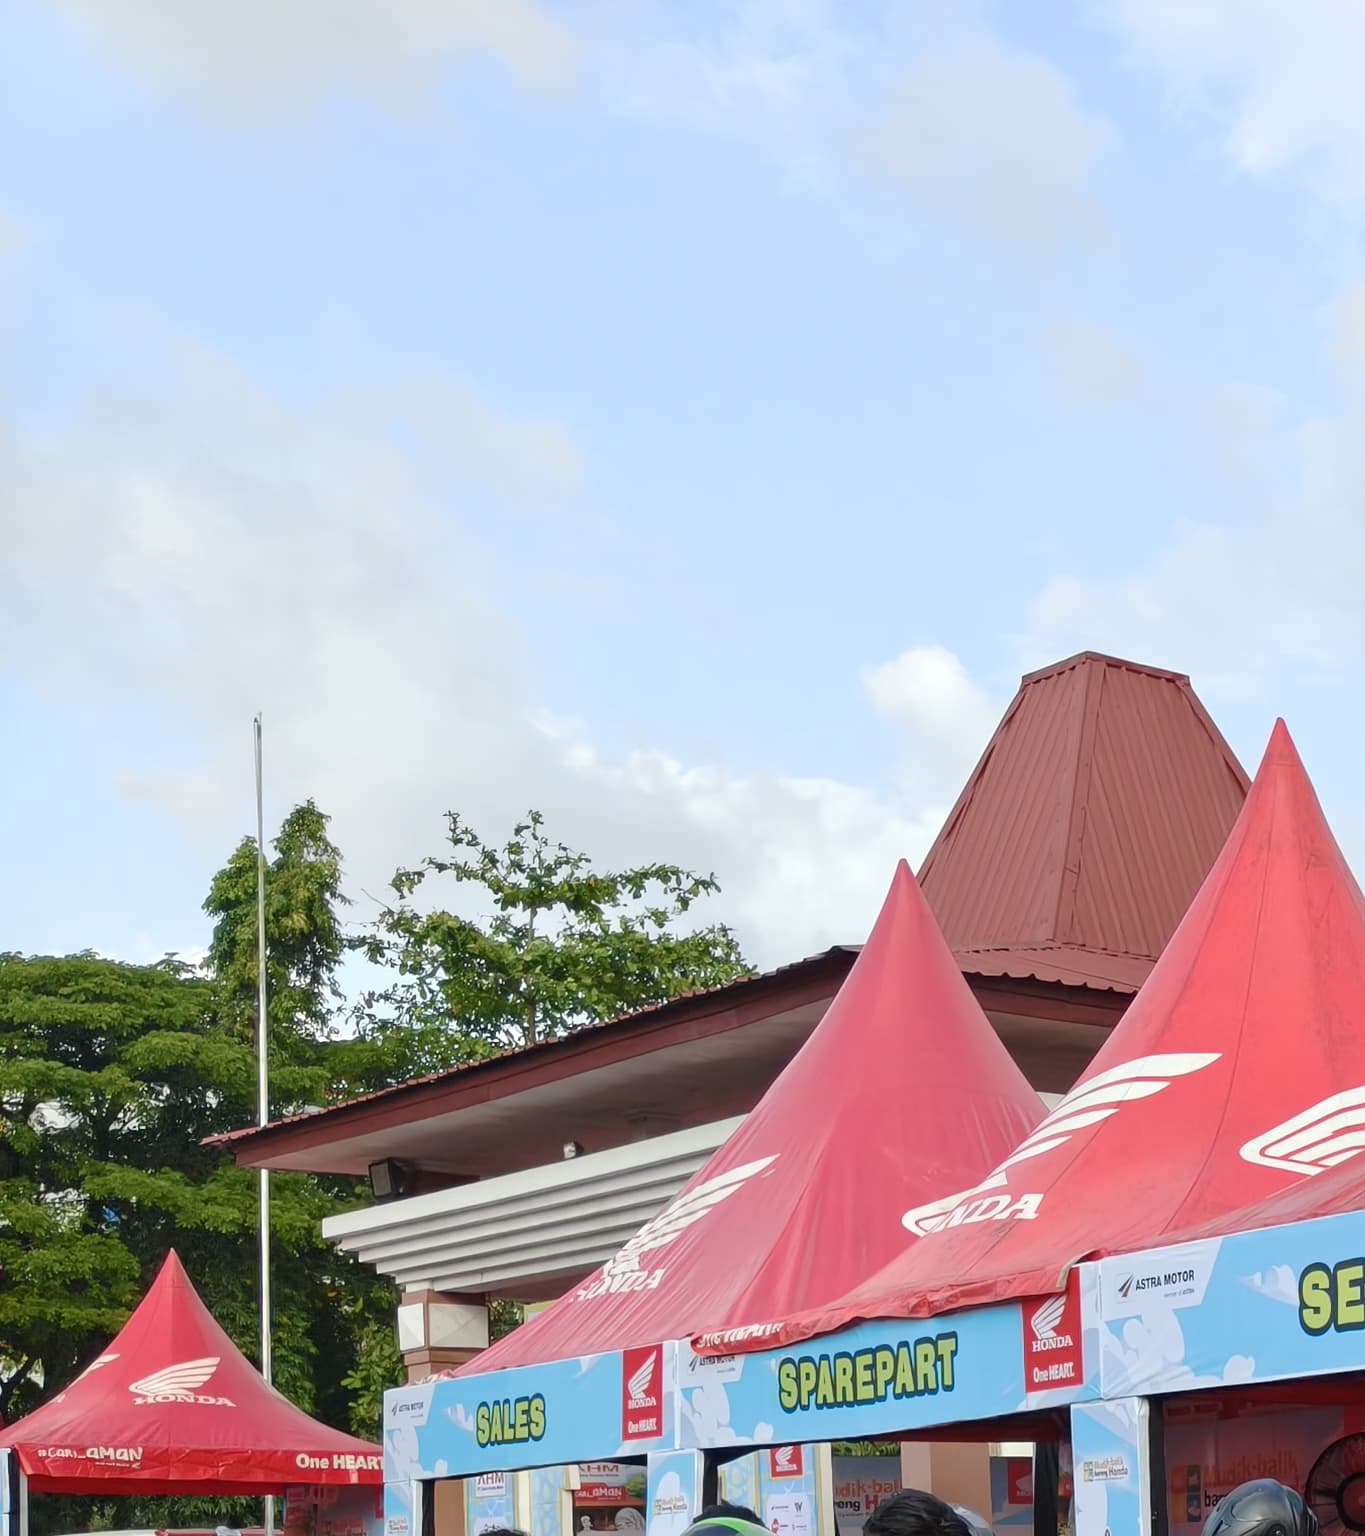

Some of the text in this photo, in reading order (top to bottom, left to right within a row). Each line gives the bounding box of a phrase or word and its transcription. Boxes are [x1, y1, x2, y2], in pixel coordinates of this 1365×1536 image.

[1135, 1269, 1195, 1291] ASTRA MOTOR
[1031, 1334, 1073, 1353] HONDA
[778, 1331, 958, 1413] SPAREPART
[1033, 1366, 1049, 1382] One
[133, 1394, 236, 1408] HONDA
[628, 1397, 657, 1410] HONDA
[476, 1393, 547, 1448] SALES
[628, 1421, 639, 1434] One
[296, 1454, 329, 1470] One
